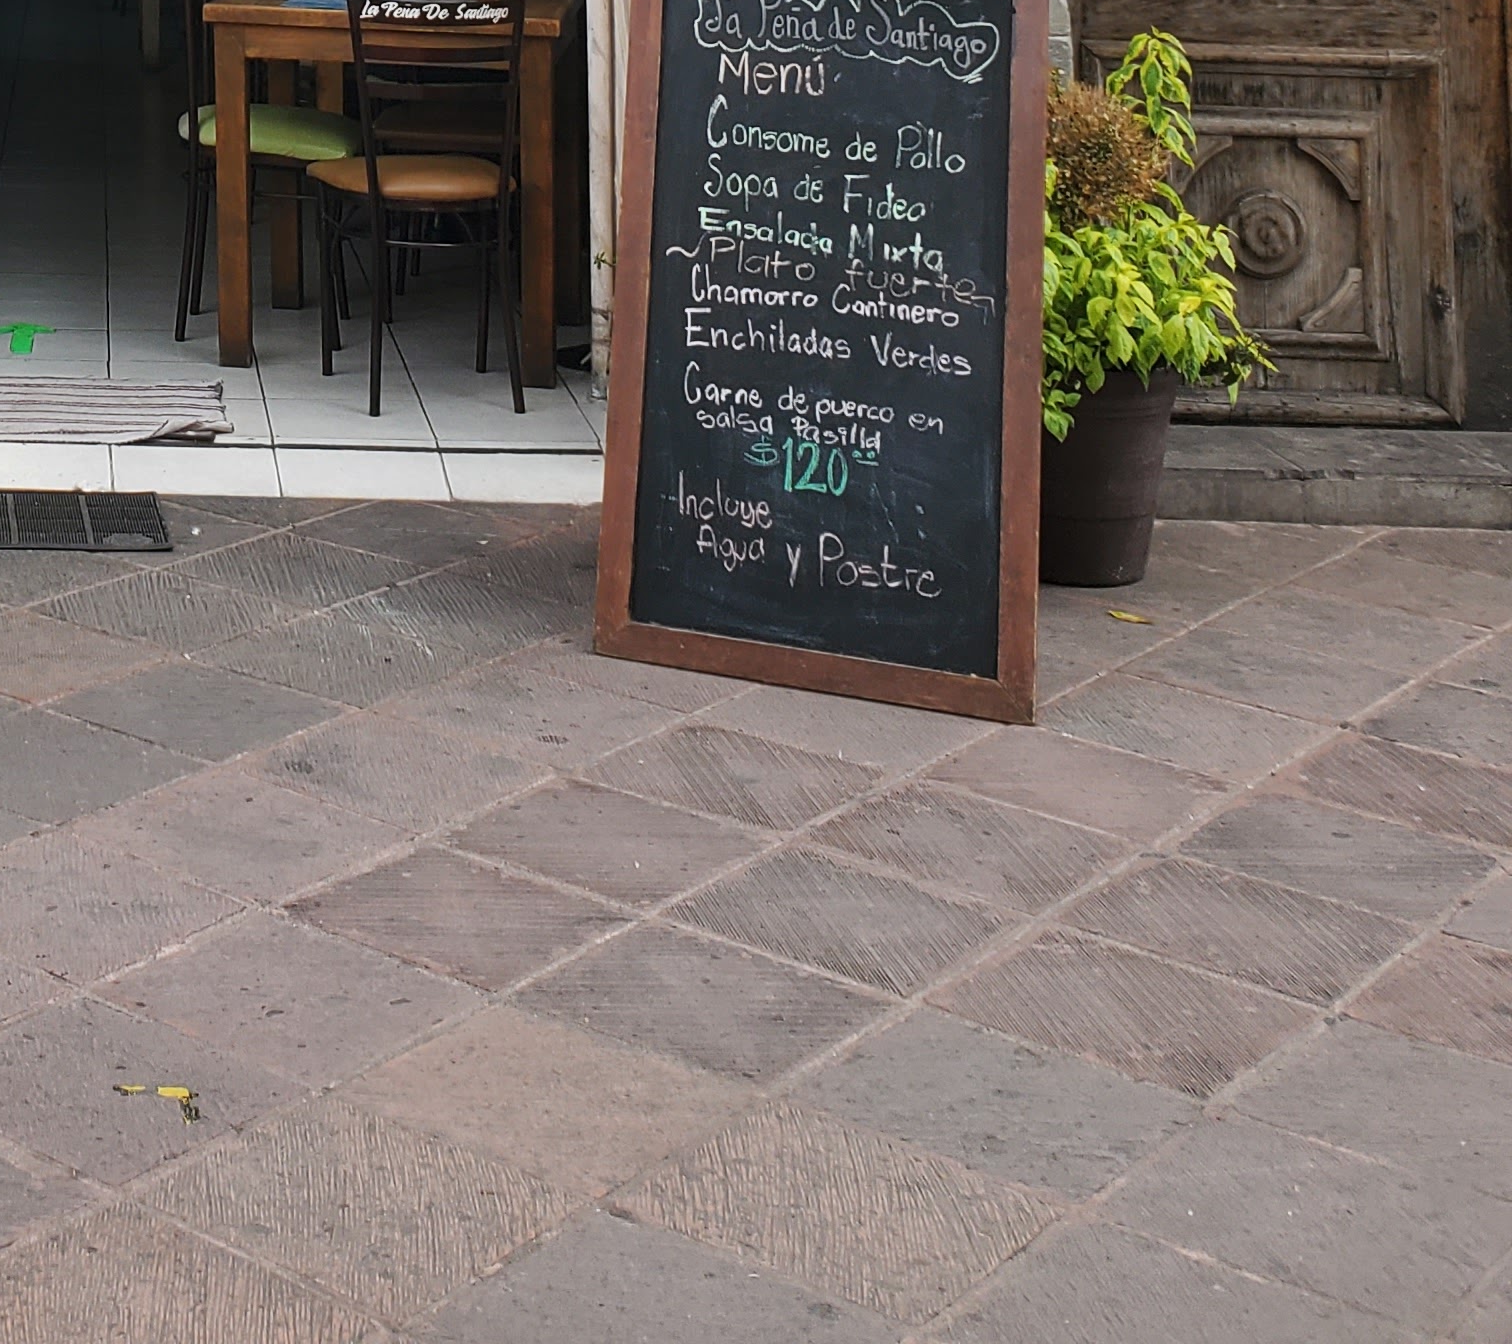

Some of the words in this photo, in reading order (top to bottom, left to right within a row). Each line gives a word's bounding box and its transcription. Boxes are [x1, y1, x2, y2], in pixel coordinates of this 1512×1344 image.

[360, 0, 379, 19] La
[422, 4, 450, 20] De
[454, 2, 510, 24] Santiago
[829, 7, 856, 40] de
[719, 50, 825, 96] Menú
[706, 94, 831, 159] Consome
[845, 132, 877, 162] de
[895, 123, 966, 173] Pollo
[703, 153, 779, 212] Sopa
[794, 173, 824, 203] de
[842, 174, 927, 222] Fideo
[698, 207, 833, 255] Ensalada
[848, 222, 944, 275] Mixta
[691, 263, 818, 307] Chamorro
[832, 283, 960, 327] Cantinero
[684, 307, 851, 360] Enchiladas
[870, 332, 972, 376] Verdes
[684, 360, 763, 405] Carne
[778, 385, 809, 413] de
[815, 397, 895, 423] puerco
[908, 412, 943, 435] en
[696, 405, 774, 435] salsa
[791, 416, 881, 452] Pasilla
[677, 470, 773, 529] Incluye
[696, 524, 765, 571] Agua
[786, 542, 801, 588] y
[819, 532, 942, 598] Postre
